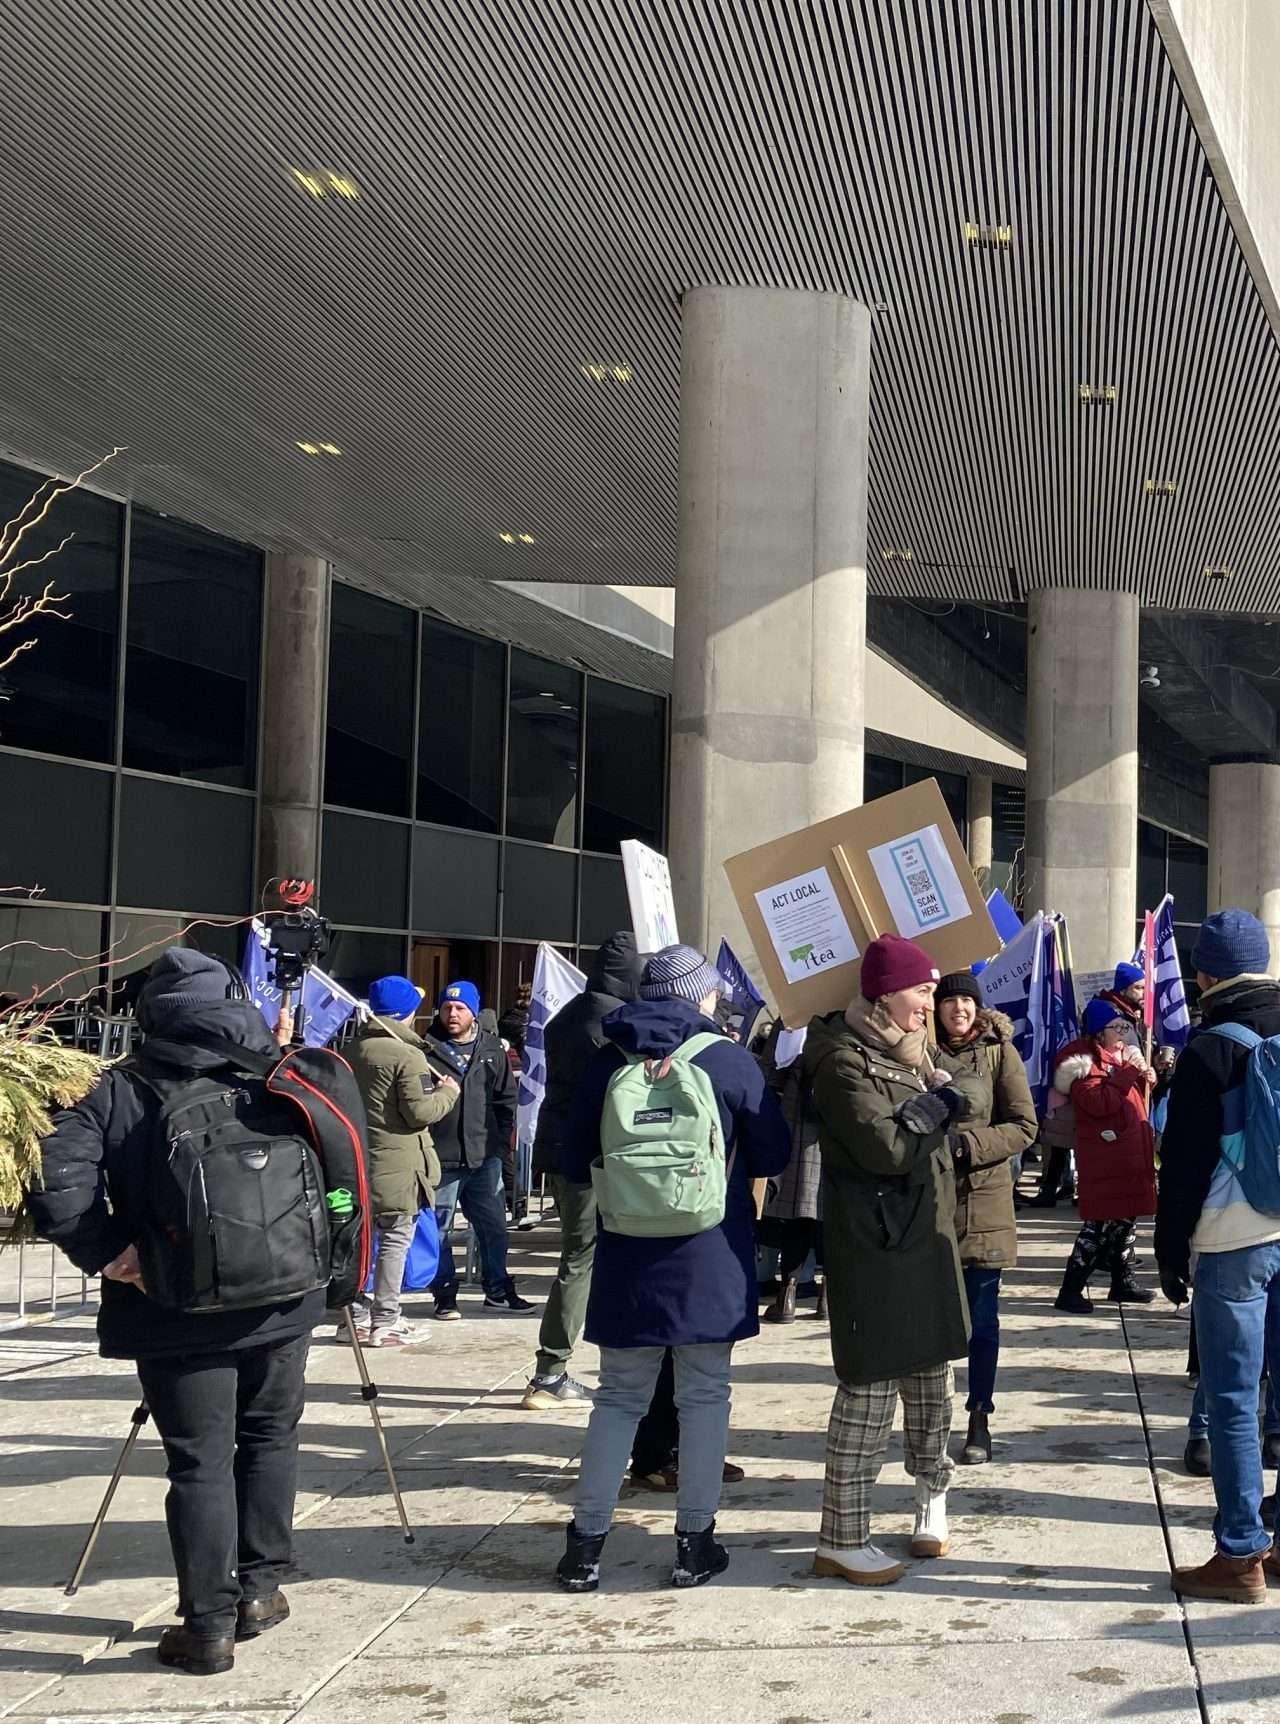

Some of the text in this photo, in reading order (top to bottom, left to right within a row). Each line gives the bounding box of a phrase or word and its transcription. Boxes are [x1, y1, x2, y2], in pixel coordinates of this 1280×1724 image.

[771, 882, 821, 910] ACT LOCAL
[917, 893, 937, 908] SCAN
[921, 904, 941, 918] HERE
[986, 974, 1010, 994] CUPE
